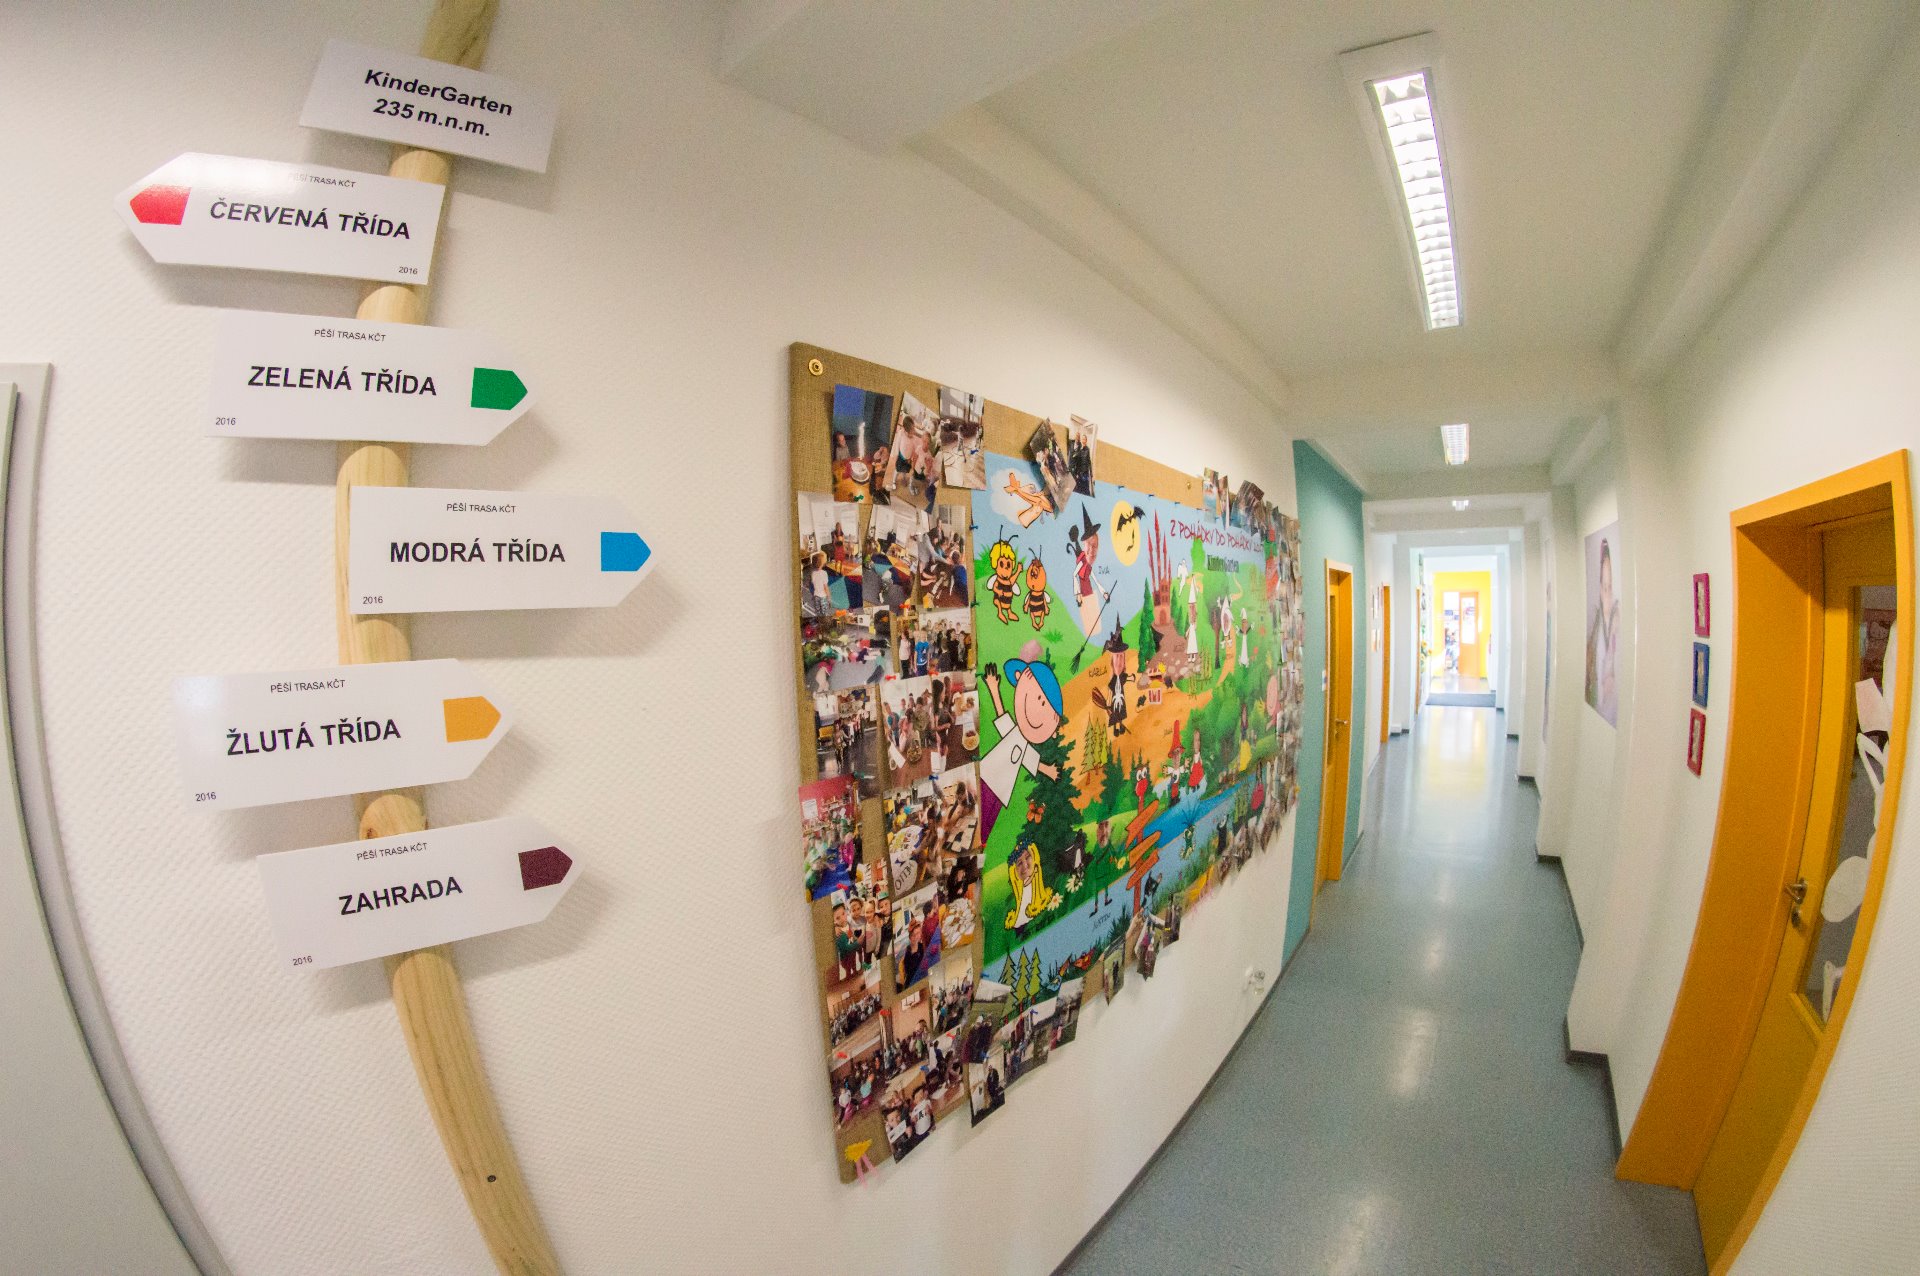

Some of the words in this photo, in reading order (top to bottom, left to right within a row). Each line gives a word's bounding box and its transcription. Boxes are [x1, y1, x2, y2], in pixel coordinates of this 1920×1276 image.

[365, 70, 513, 116] KinderGarten
[373, 99, 414, 119] 235
[418, 107, 491, 136] m.n.m.
[309, 175, 337, 186] TRASA
[338, 178, 357, 188] KČT
[210, 197, 329, 230] ČERVENÁ
[339, 211, 410, 240] TŘÍDA
[398, 266, 418, 275] 2016
[314, 327, 335, 338] PĚŠÍ
[337, 330, 367, 341] TRASA
[368, 331, 387, 342] KČT
[247, 365, 352, 391] ZELENÁ
[361, 368, 437, 396] TŘÍDA
[215, 416, 236, 426] 2016
[446, 502, 467, 512] PĚŠÍ
[469, 504, 498, 513] TRASA
[499, 503, 516, 513] KČT
[1215, 528, 1226, 546] DO
[390, 537, 486, 563] MODRÁ
[492, 538, 566, 563] TŘÍDA
[362, 595, 384, 605] 2016
[270, 682, 292, 693] PĚŠÍ
[294, 680, 326, 692] TRASA
[326, 678, 346, 689] KČT
[226, 721, 315, 756] ŽLUTÁ
[320, 716, 402, 746] TŘÍDA
[195, 791, 217, 802] 2016
[356, 849, 378, 861] PĚŠÍ
[378, 846, 409, 857] TRASA
[410, 842, 428, 853] KČT
[338, 876, 463, 916] ZAHRADA
[292, 955, 313, 966] 2016
